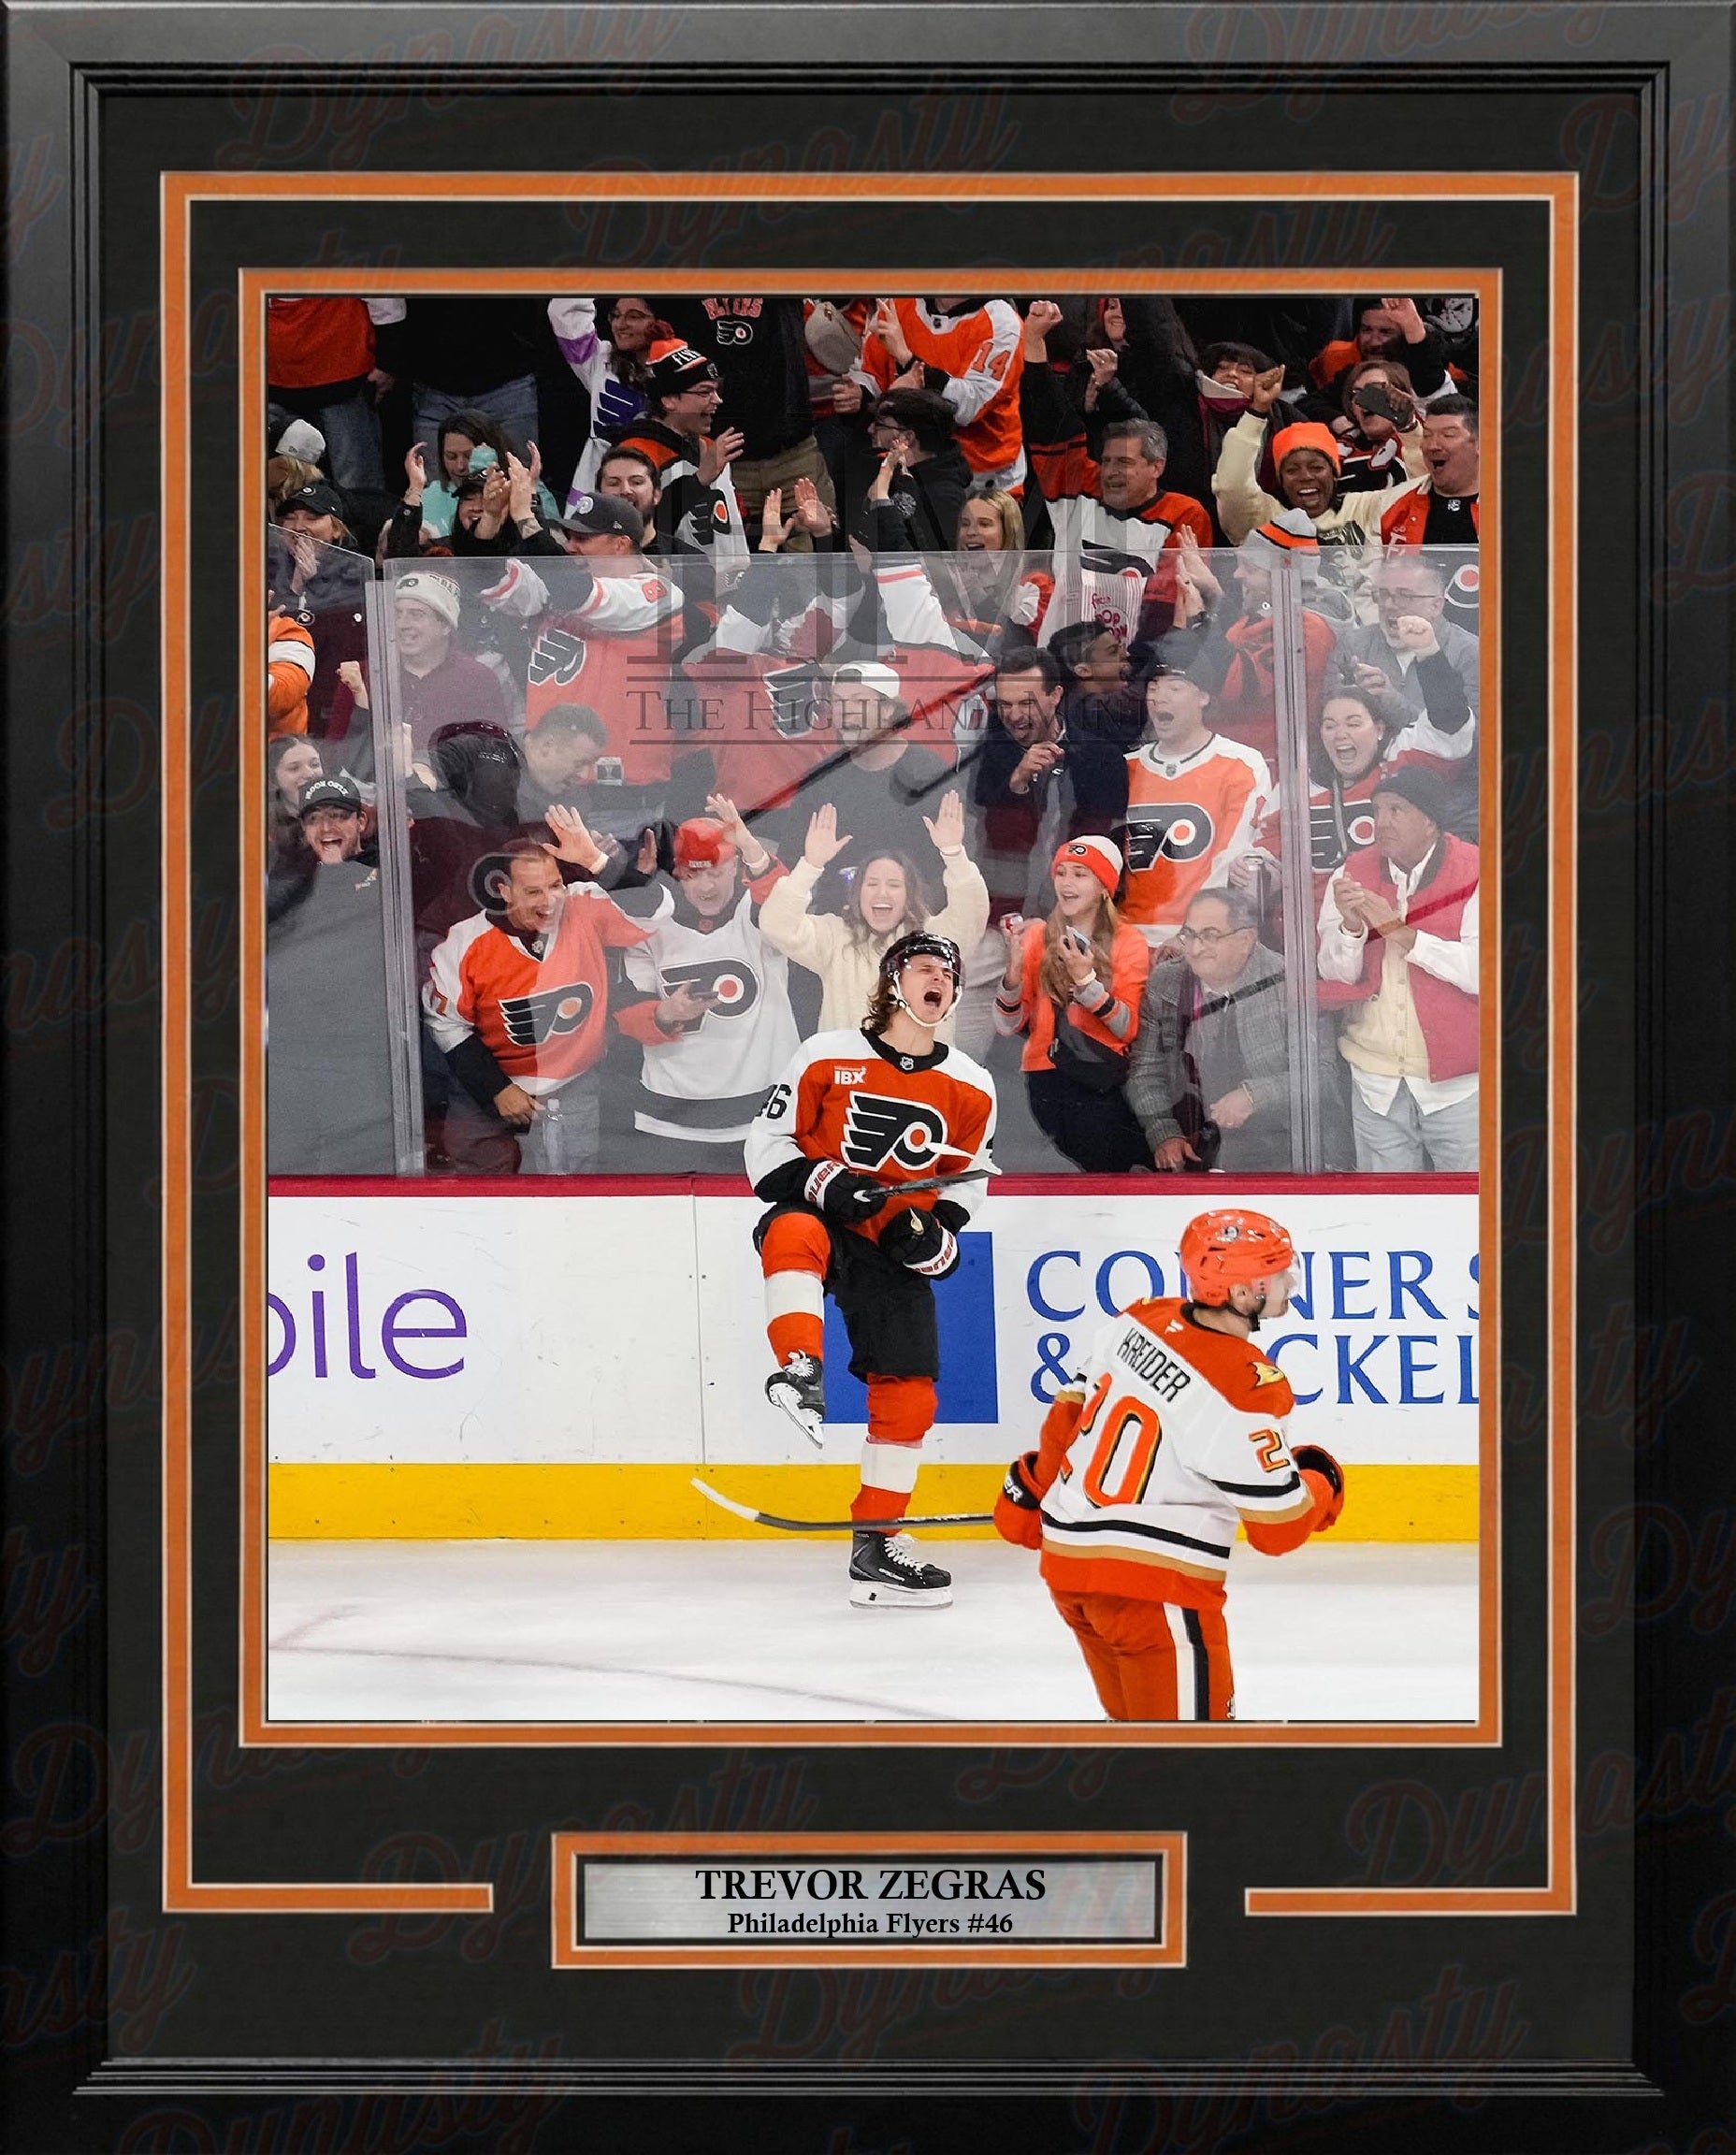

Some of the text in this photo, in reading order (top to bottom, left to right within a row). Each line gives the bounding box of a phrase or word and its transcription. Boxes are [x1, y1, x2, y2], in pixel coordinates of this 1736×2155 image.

[972, 342, 1010, 382] 14
[833, 1070, 865, 1085] IBX
[1116, 1326, 1191, 1403] KREIDER
[1248, 1428, 1290, 1473] 2
[695, 1868, 1047, 1902] TREVOR ZEGRAS
[727, 1912, 1014, 1938] Philadelphia Flyers #46
